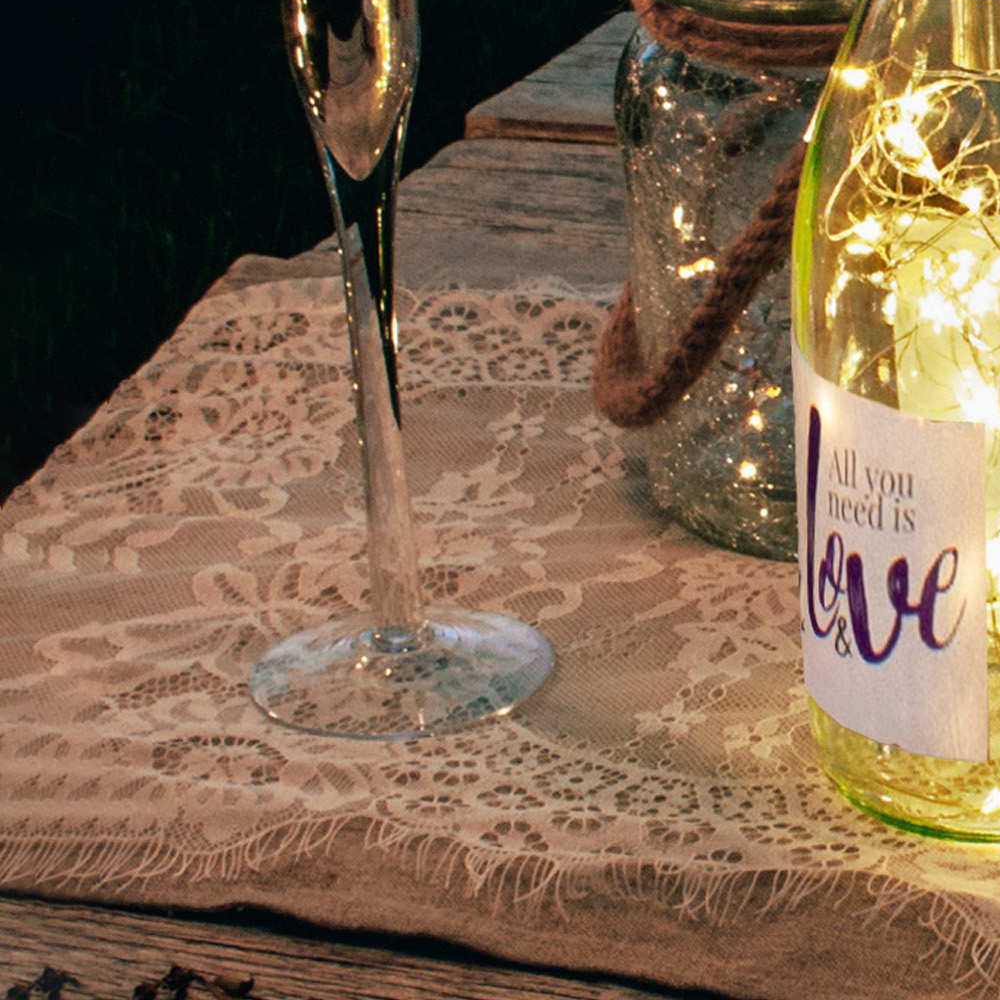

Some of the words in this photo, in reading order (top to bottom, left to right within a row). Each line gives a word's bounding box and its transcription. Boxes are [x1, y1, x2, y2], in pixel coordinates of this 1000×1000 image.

[828, 448, 857, 490] All
[864, 462, 914, 502] you
[806, 403, 968, 665] love
[828, 489, 884, 531] need
[894, 498, 916, 533] is
[835, 614, 852, 658] &
